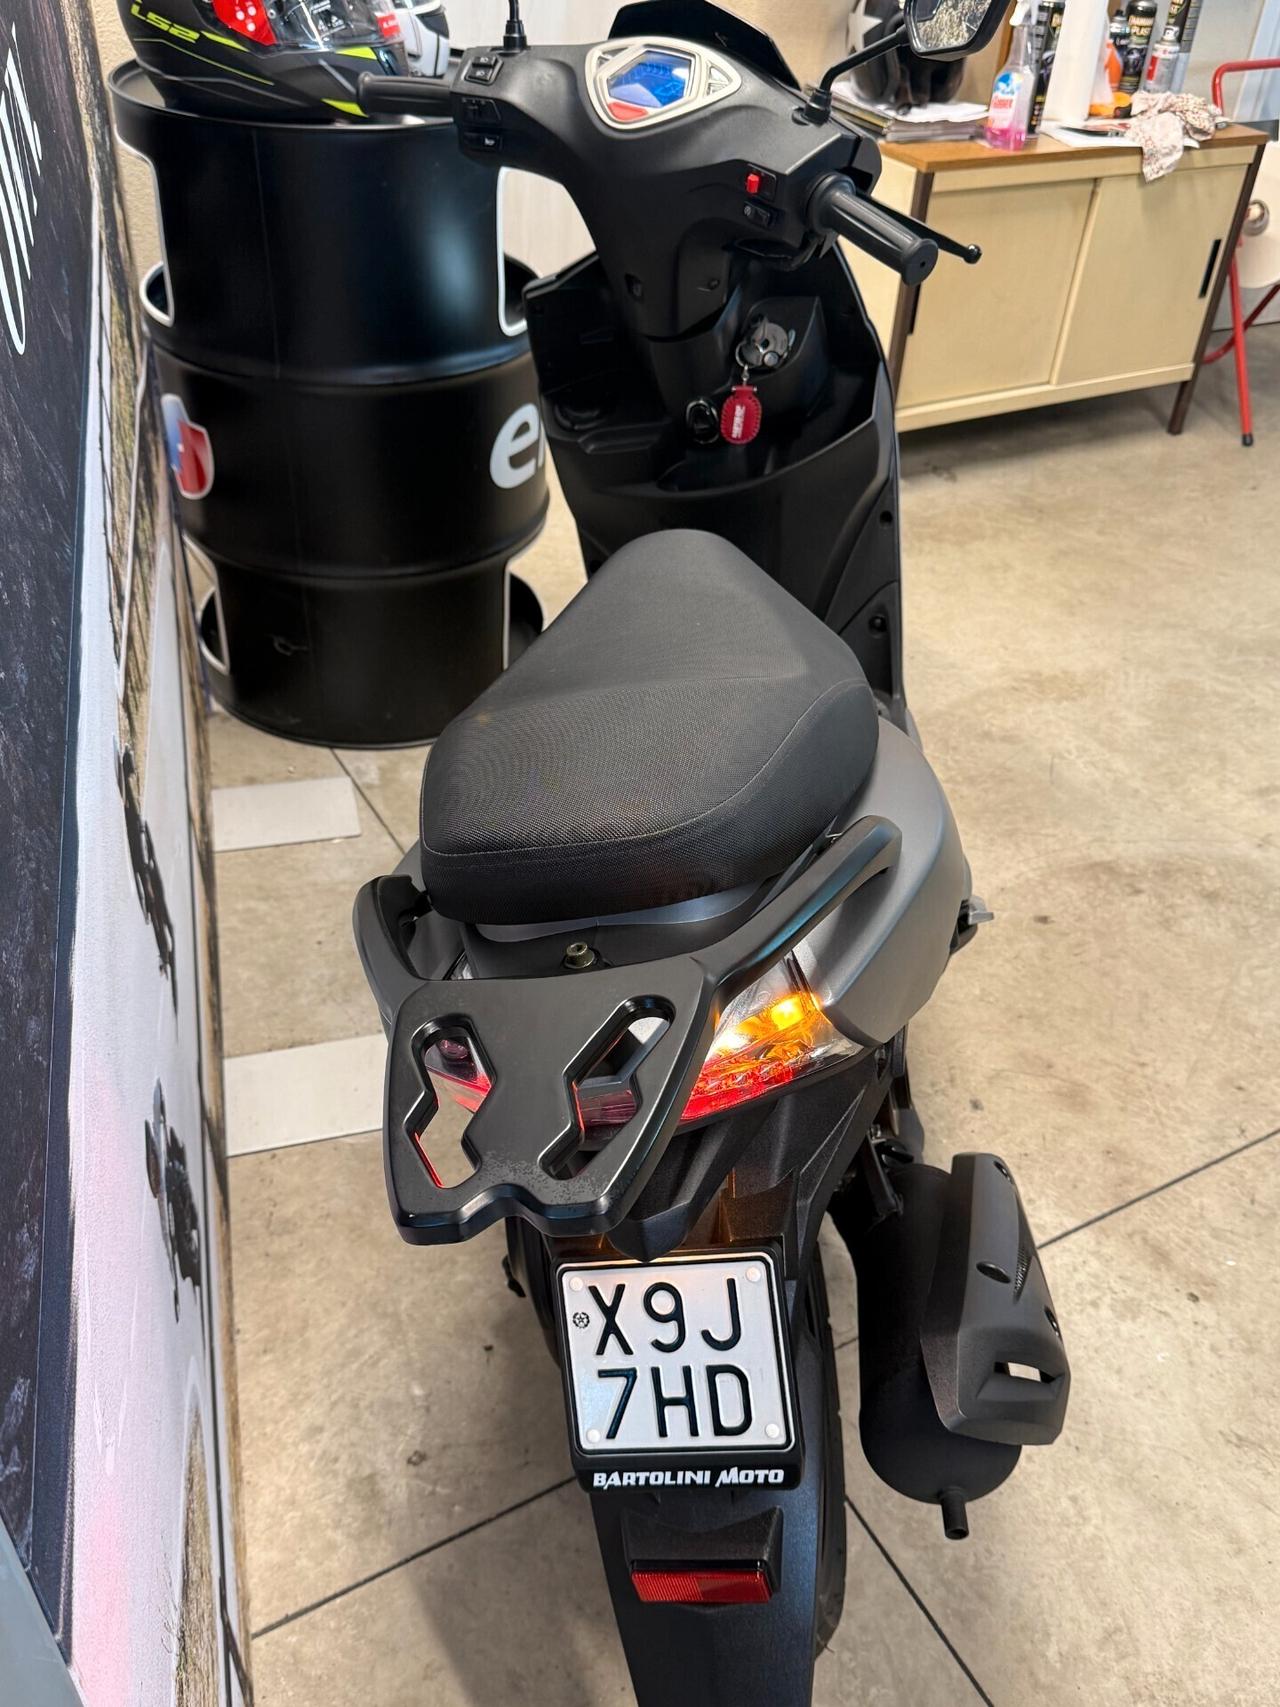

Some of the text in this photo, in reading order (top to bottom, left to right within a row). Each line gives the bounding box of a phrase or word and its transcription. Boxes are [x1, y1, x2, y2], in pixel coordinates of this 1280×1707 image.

[131, 4, 200, 43] LS2
[490, 403, 545, 489] e
[588, 1277, 742, 1356] X9J
[597, 1363, 753, 1440] 7HD
[593, 1466, 785, 1490] BARTOLINI MOTO
